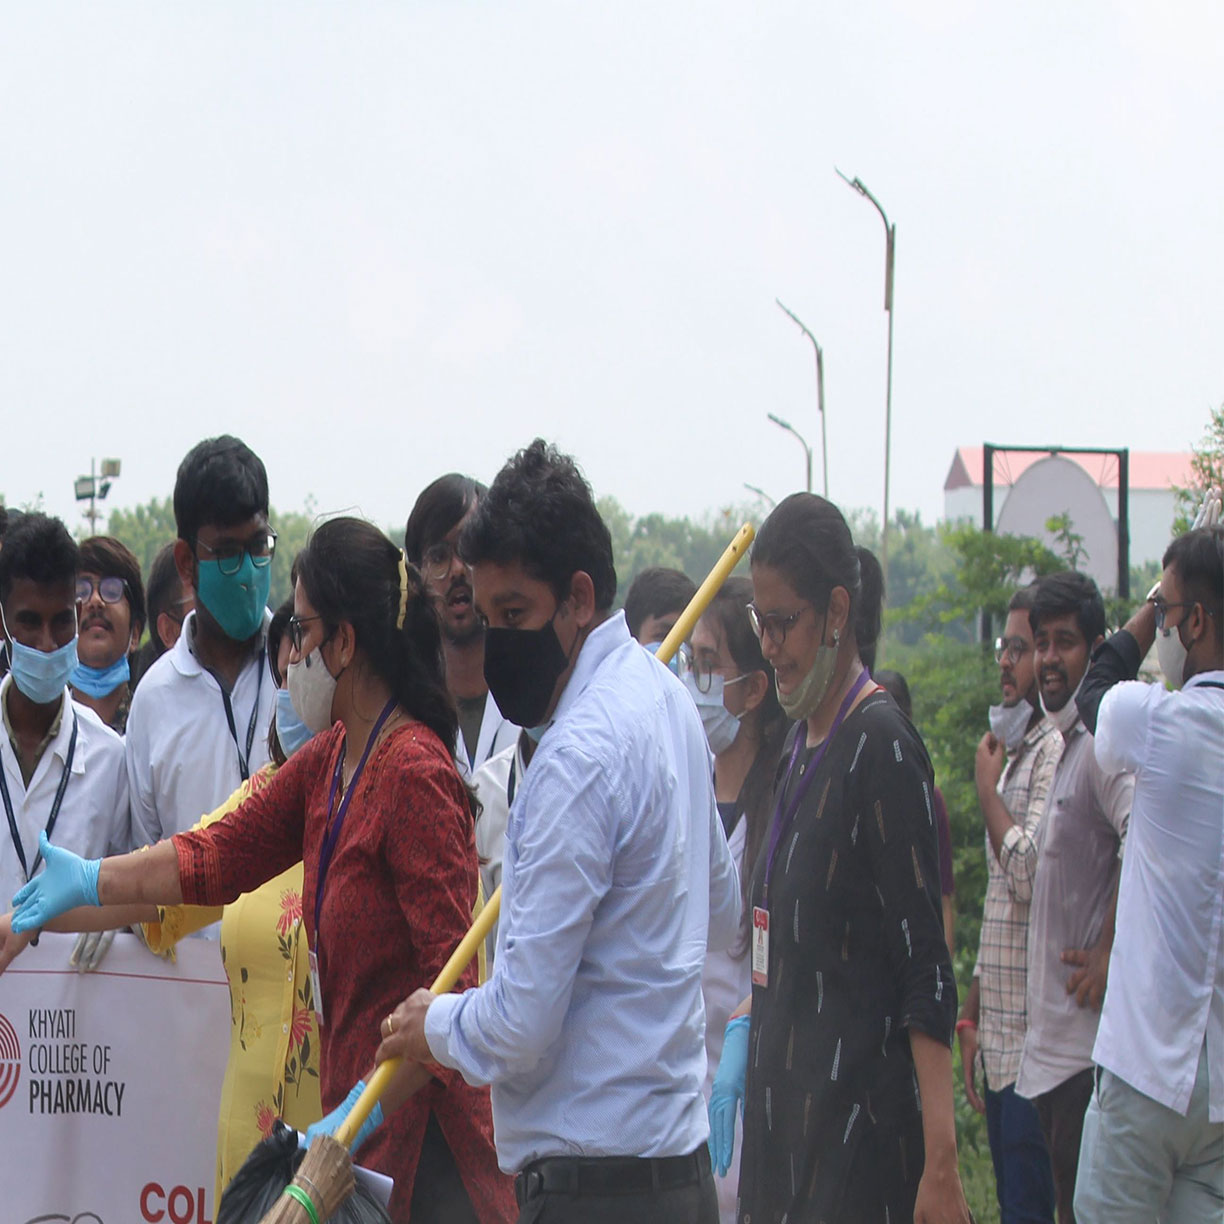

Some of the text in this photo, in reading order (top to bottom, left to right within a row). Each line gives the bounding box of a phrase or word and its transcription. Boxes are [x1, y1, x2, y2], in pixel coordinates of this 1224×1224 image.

[29, 1009, 75, 1039] KHYATI
[29, 1044, 111, 1075] COLLEGE OF
[29, 1078, 125, 1116] PHARMACY
